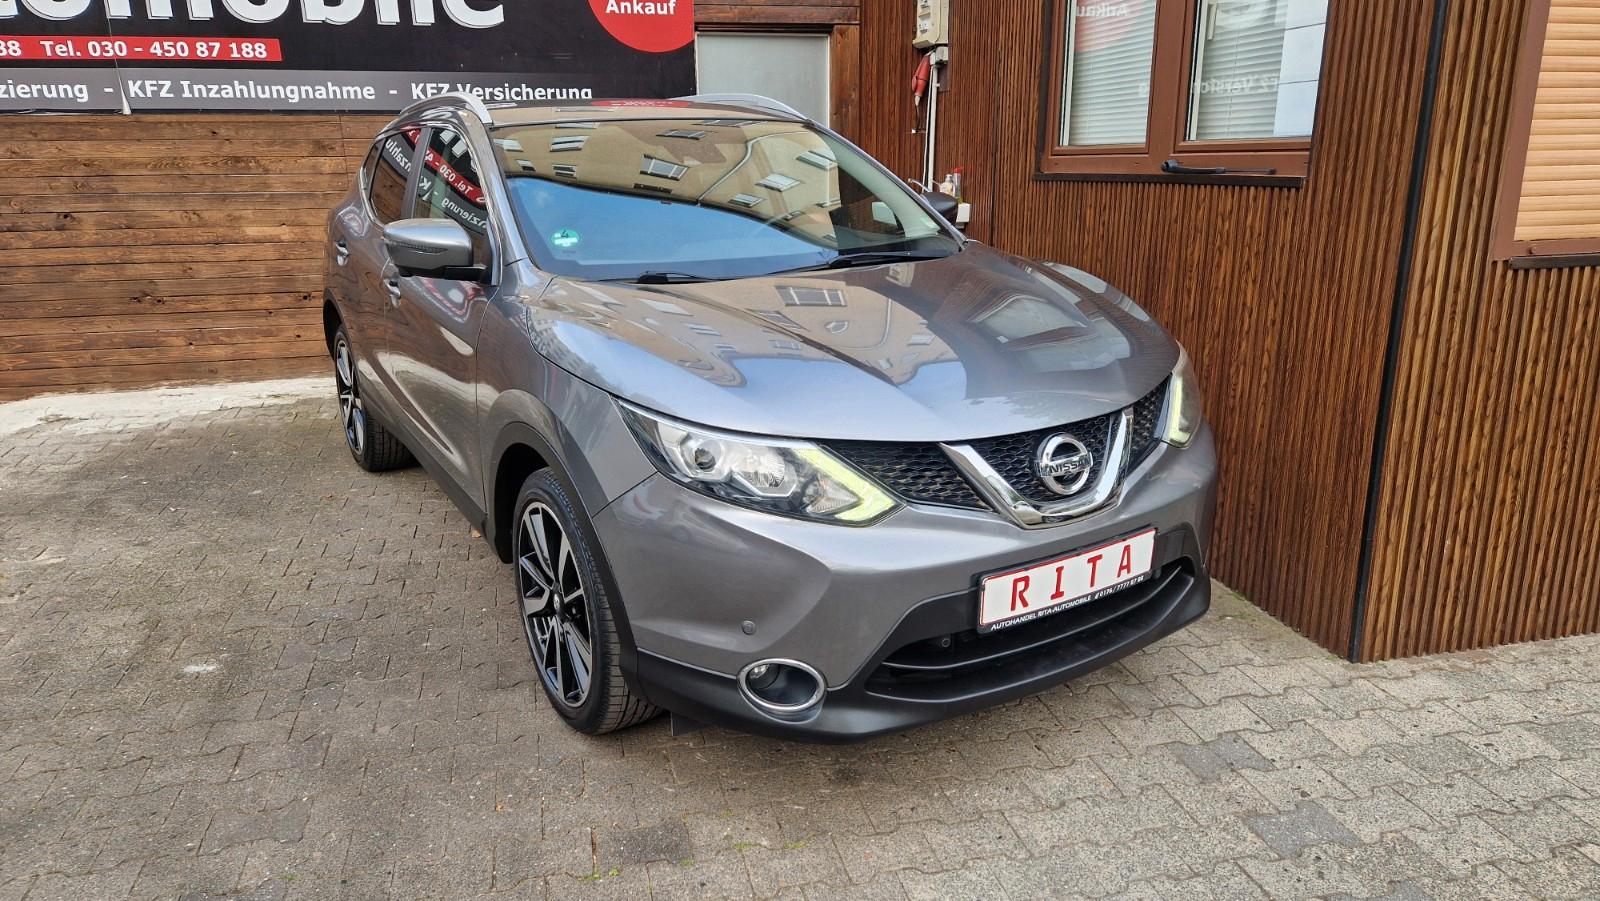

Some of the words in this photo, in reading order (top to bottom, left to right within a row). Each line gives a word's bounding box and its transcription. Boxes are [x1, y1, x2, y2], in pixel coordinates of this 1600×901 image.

[605, 0, 677, 15] Ankauf
[40, 40, 82, 57] Tel.
[87, 41, 127, 57] 030
[149, 41, 189, 57] 450
[195, 42, 221, 58] 87
[229, 42, 268, 58] 188
[128, 80, 175, 98] KFZ
[180, 80, 376, 103] Inzahlungnahme
[1050, 455, 1089, 474] NISSAN
[990, 612, 1037, 632] AUTOHANDEL
